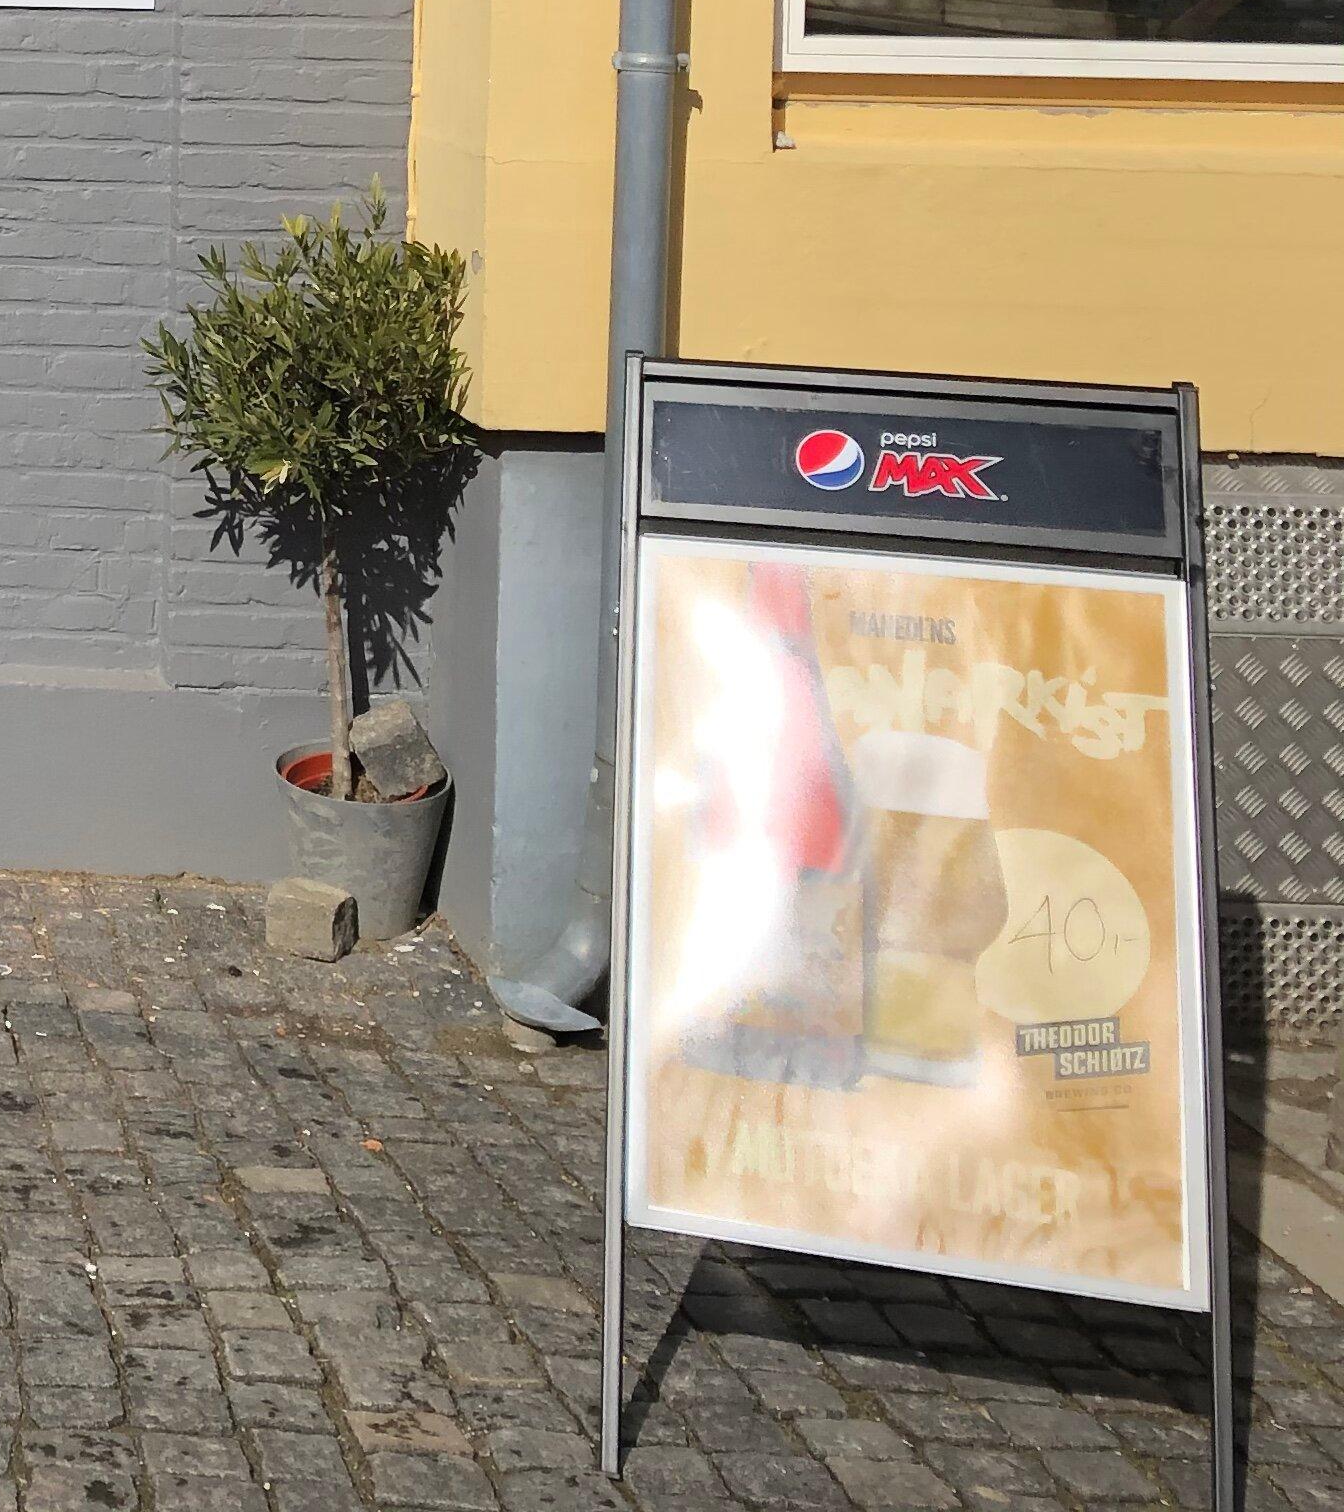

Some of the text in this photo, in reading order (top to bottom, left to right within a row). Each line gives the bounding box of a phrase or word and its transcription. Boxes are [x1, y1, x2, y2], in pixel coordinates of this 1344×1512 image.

[880, 432, 937, 448] pepsi
[868, 450, 1005, 501] MAX
[1019, 1022, 1114, 1051] THEODOR
[1060, 1046, 1146, 1076] SCHIØTZ
